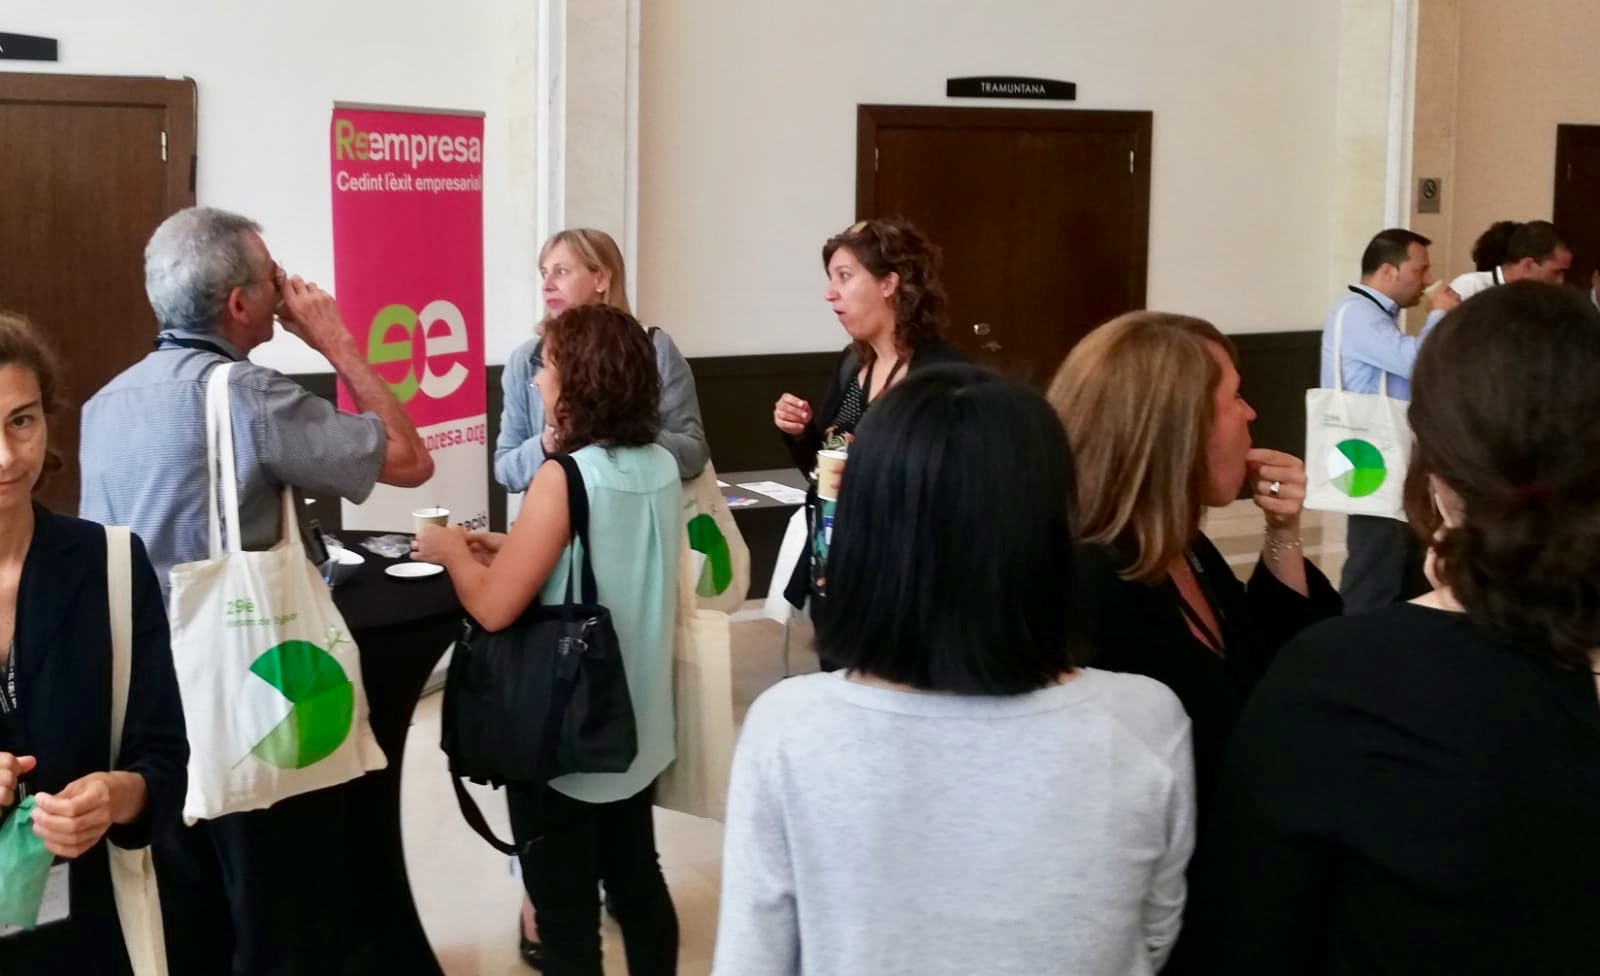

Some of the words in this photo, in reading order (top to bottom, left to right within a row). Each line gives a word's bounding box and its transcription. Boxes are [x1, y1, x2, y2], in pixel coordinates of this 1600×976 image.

[980, 82, 1046, 95] TRAMUNTANA
[335, 119, 481, 169] Reempresa
[336, 170, 383, 191] Cedint
[415, 174, 482, 194] empresarial
[421, 423, 486, 451] presa.org
